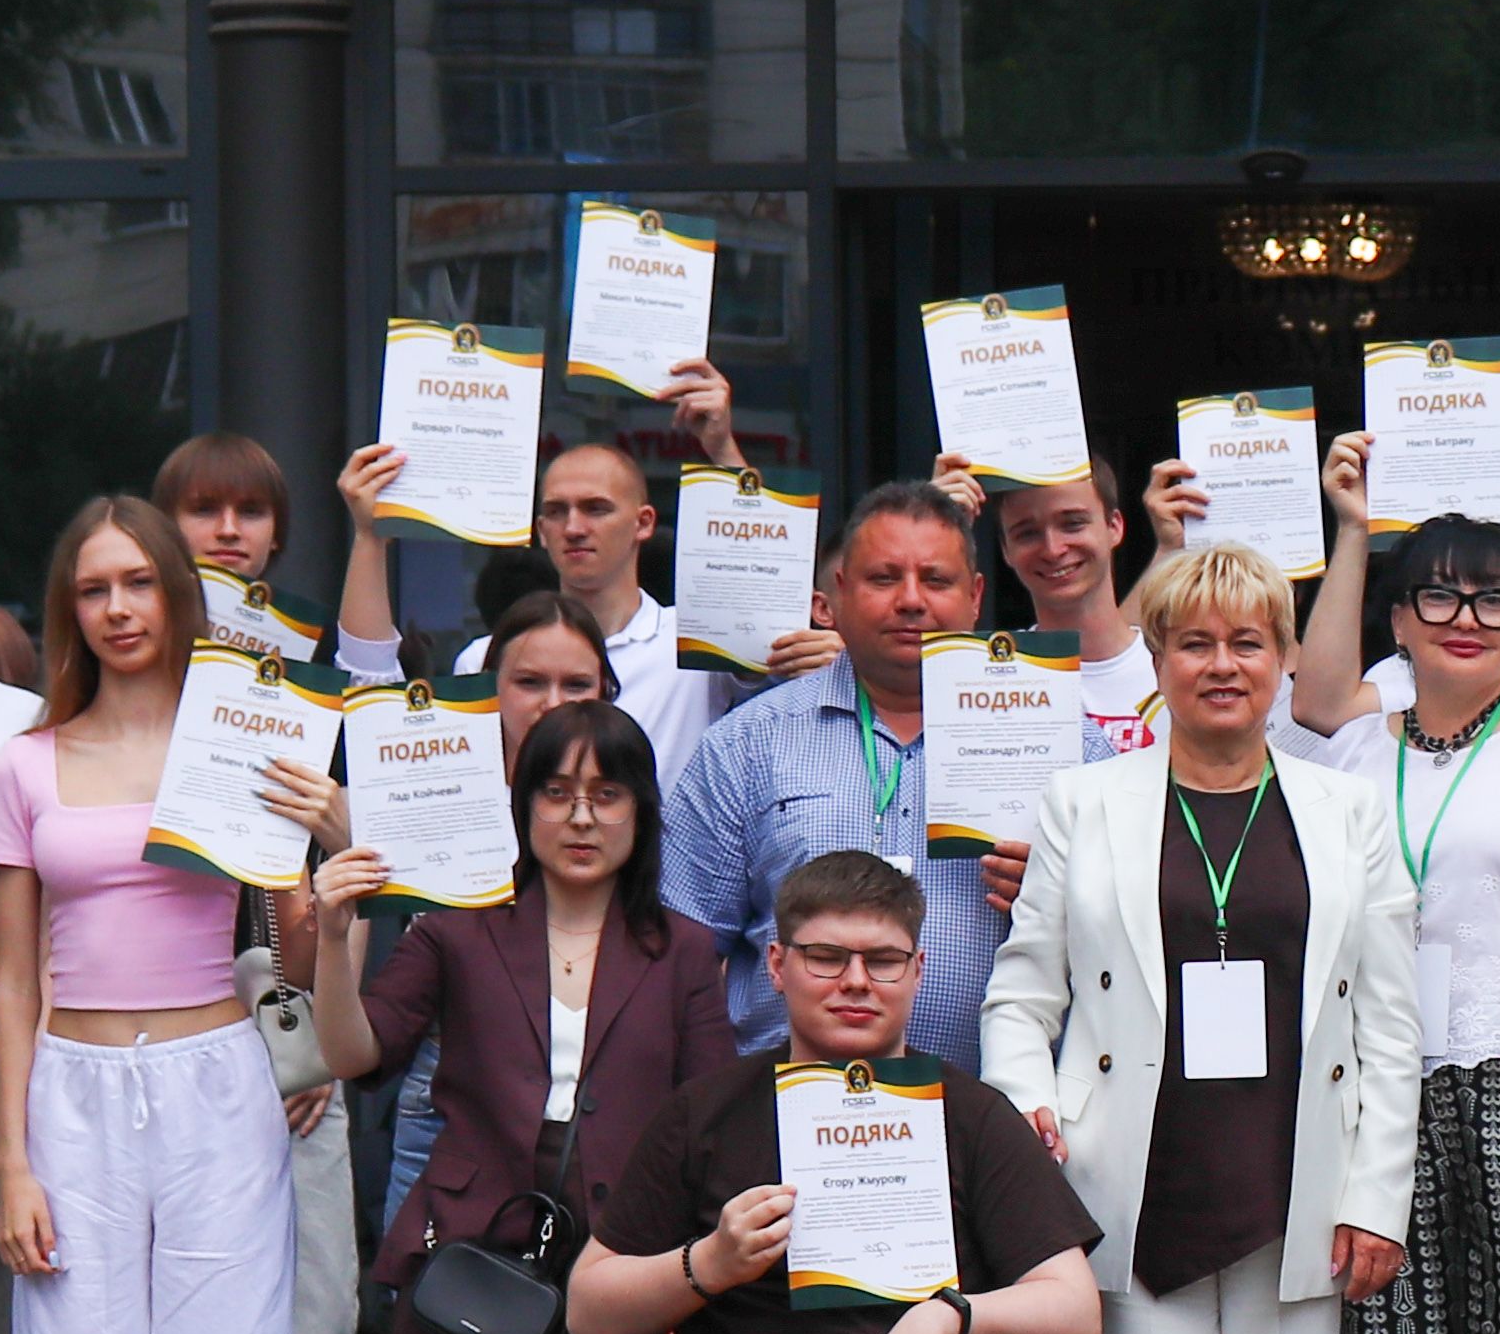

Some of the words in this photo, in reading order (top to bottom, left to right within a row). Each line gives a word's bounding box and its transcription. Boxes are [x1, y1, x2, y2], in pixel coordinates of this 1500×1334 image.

[607, 254, 689, 277] ПОДЯКА
[959, 339, 1046, 366] ПОДЯКА
[417, 378, 510, 402] ПОДЯКА
[1398, 392, 1487, 415] ПОДЯКА
[454, 424, 504, 439] Гончарук
[1434, 436, 1475, 449] Батраку
[1208, 438, 1291, 461] ПОДЯКА
[706, 520, 788, 542] ПОДЯКА
[959, 691, 1051, 712] ПОДЯКА
[211, 704, 308, 740] ПОДЯКА
[378, 735, 471, 763] ПОДЯКА
[957, 745, 1021, 756] Олександру
[1023, 745, 1050, 754] РУСУ
[412, 782, 462, 799] Койчевій
[841, 1096, 876, 1106] FCSECS
[816, 1121, 913, 1147] ПОДЯКА
[823, 1176, 855, 1190] Єгору
[857, 1171, 907, 1187] Жмурову
